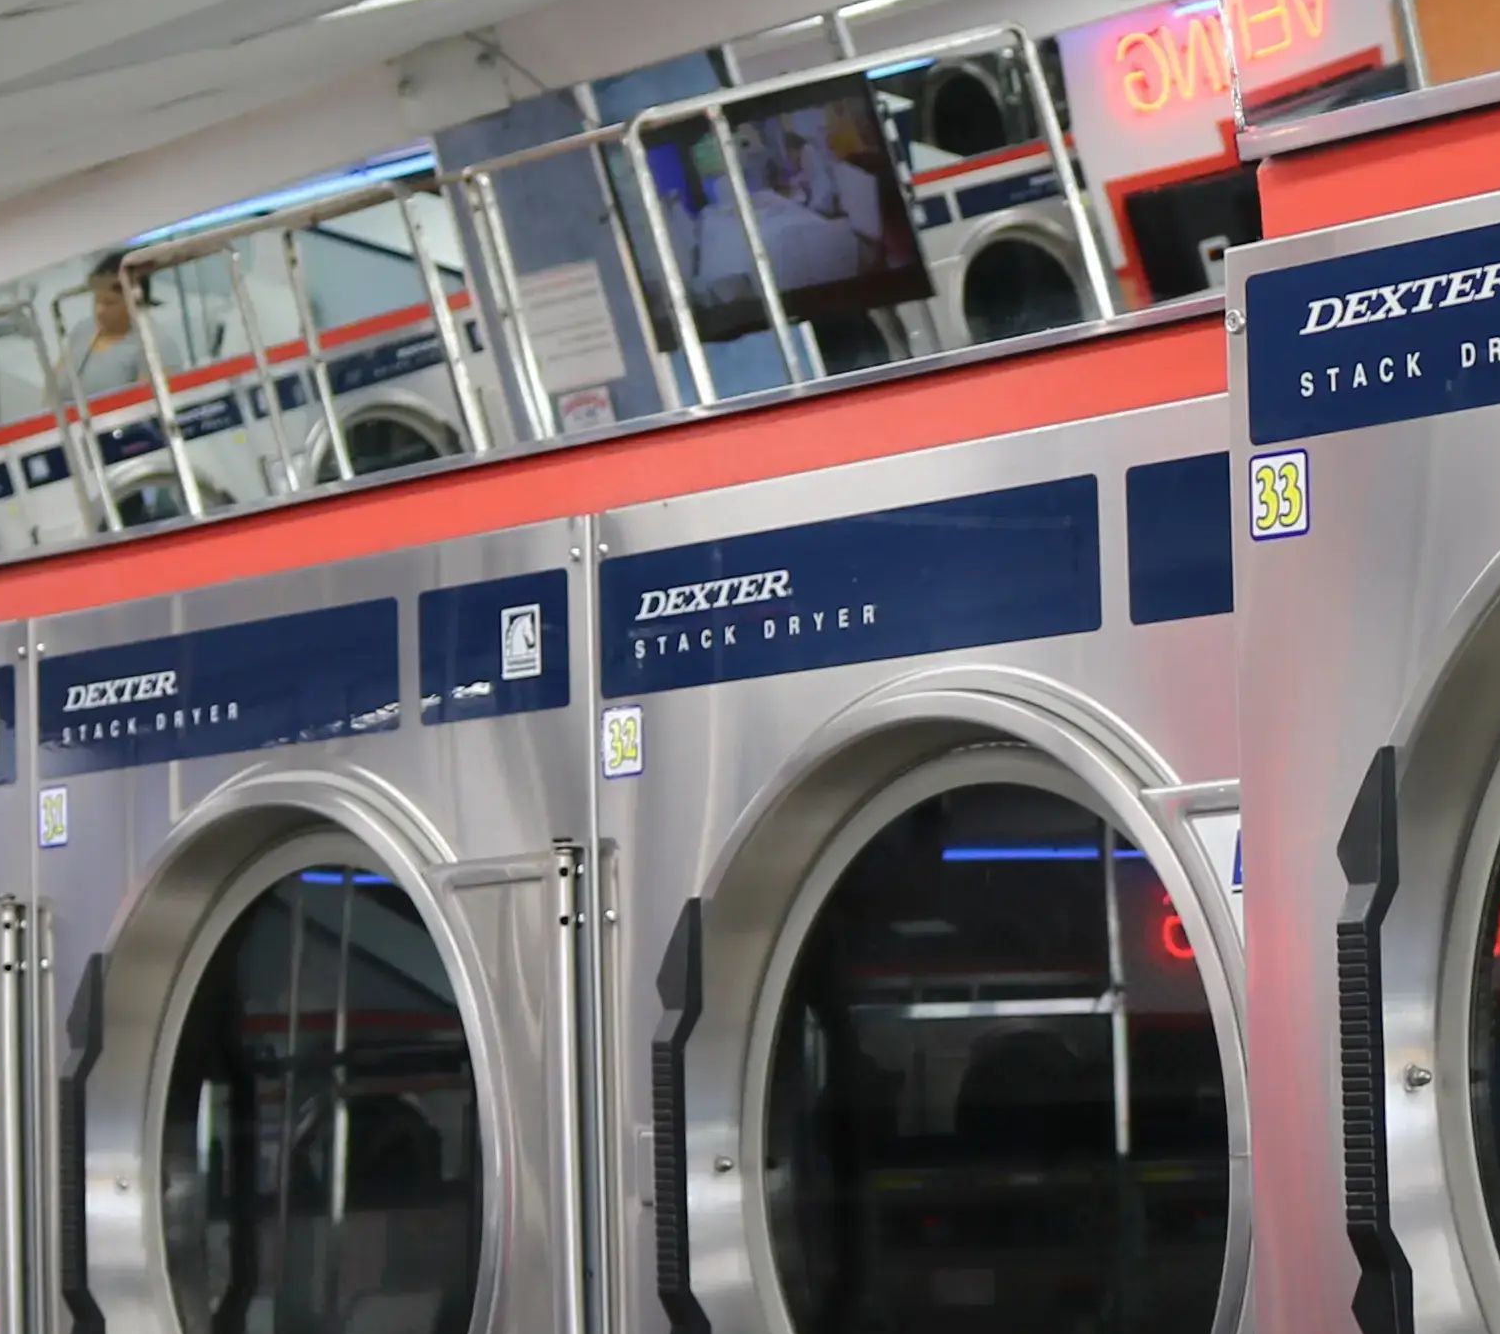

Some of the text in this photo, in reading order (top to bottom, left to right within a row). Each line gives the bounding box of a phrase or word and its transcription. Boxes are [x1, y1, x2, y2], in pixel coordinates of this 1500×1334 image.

[1299, 349, 1423, 399] STACK
[1253, 458, 1304, 532] 33
[634, 568, 791, 622] DEXTER
[634, 604, 876, 660] STACK DRYER
[62, 670, 177, 713] DEXTER
[61, 702, 240, 746] STACK DRYER
[608, 717, 639, 770] 32
